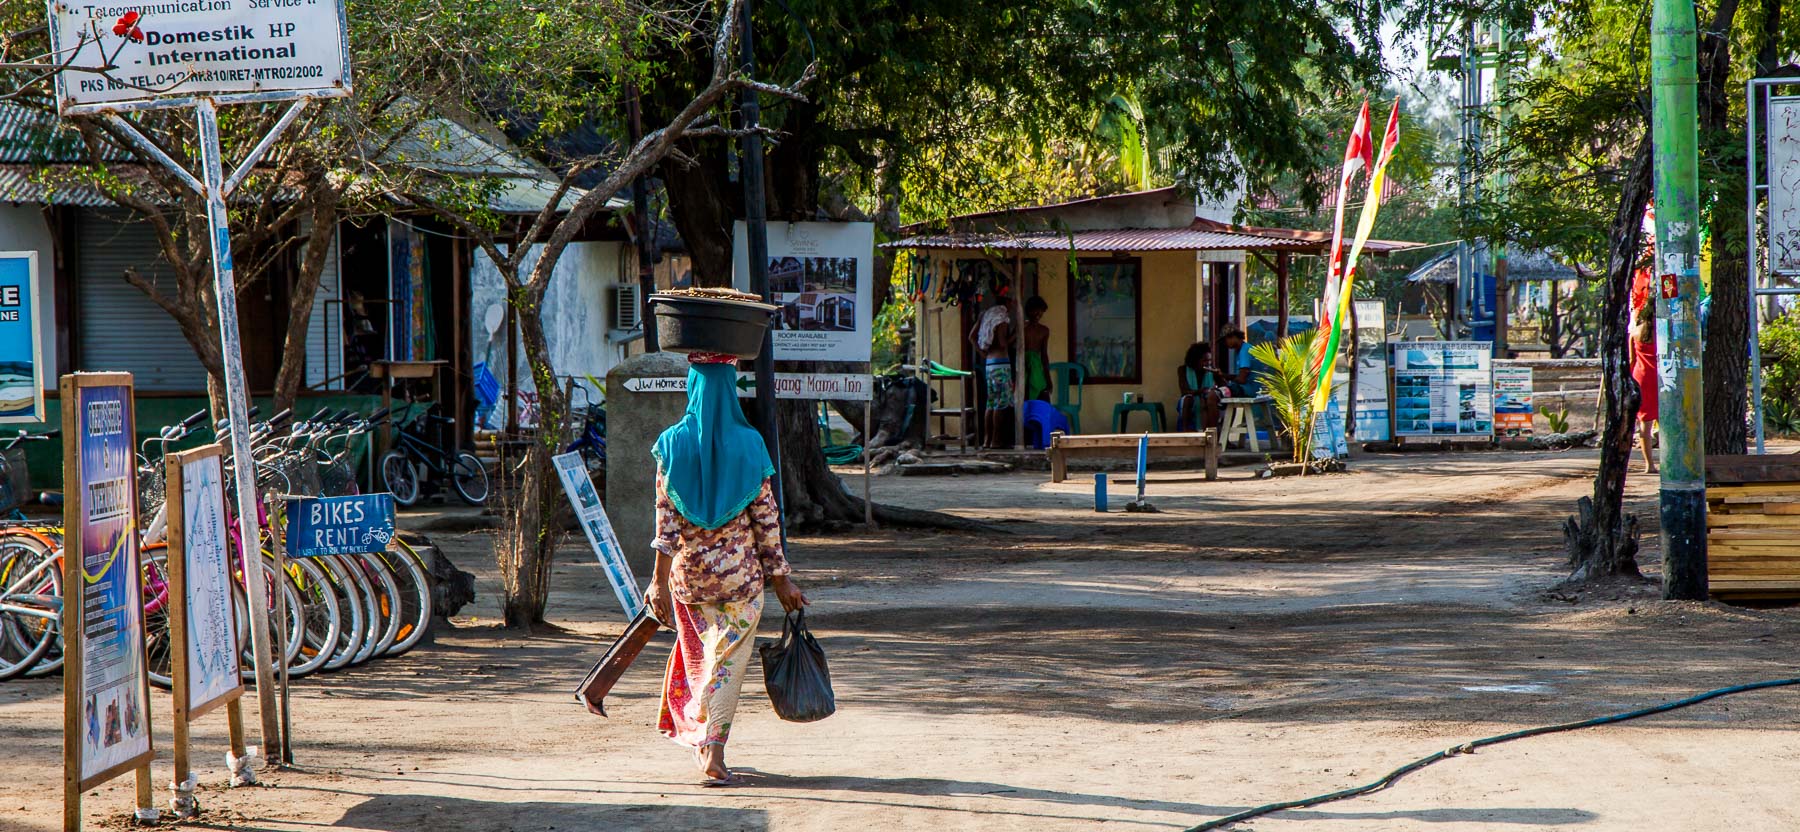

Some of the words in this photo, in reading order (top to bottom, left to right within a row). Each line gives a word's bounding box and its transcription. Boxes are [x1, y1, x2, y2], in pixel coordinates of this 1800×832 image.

[146, 25, 255, 46] Domestik
[268, 22, 296, 38] HP
[148, 42, 296, 66] International
[80, 80, 104, 92] PKS
[774, 377, 801, 395] yang
[807, 375, 838, 392] Mama
[844, 376, 861, 392] Inn
[311, 501, 365, 526] BIKES
[315, 526, 359, 548] RENT
